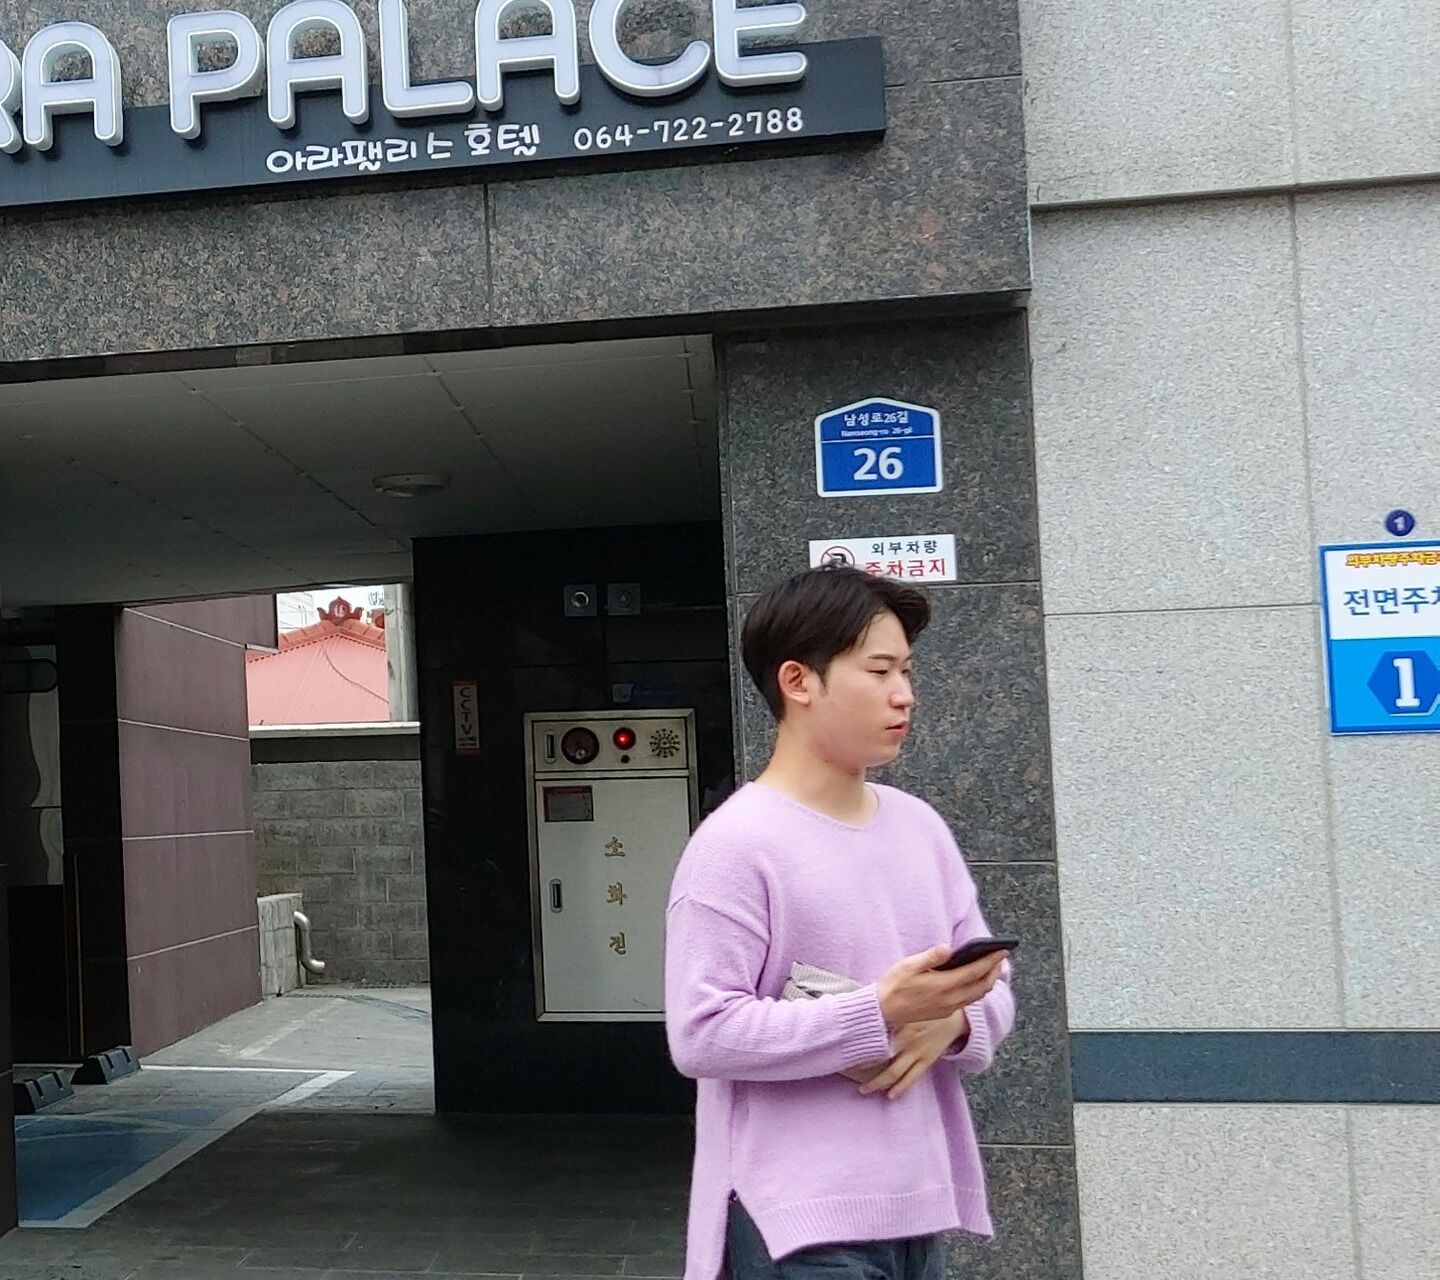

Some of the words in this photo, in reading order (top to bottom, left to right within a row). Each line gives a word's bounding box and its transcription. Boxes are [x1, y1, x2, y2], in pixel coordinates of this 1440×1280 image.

[464, 122, 541, 157] 호텔
[573, 107, 804, 150] 064-722-2788
[853, 446, 904, 481] 26
[865, 558, 946, 578] 주차금지
[871, 540, 938, 556] 외부차량
[1393, 658, 1421, 707] 1
[460, 687, 473, 735] CCTV
[604, 836, 628, 955] 소화전
